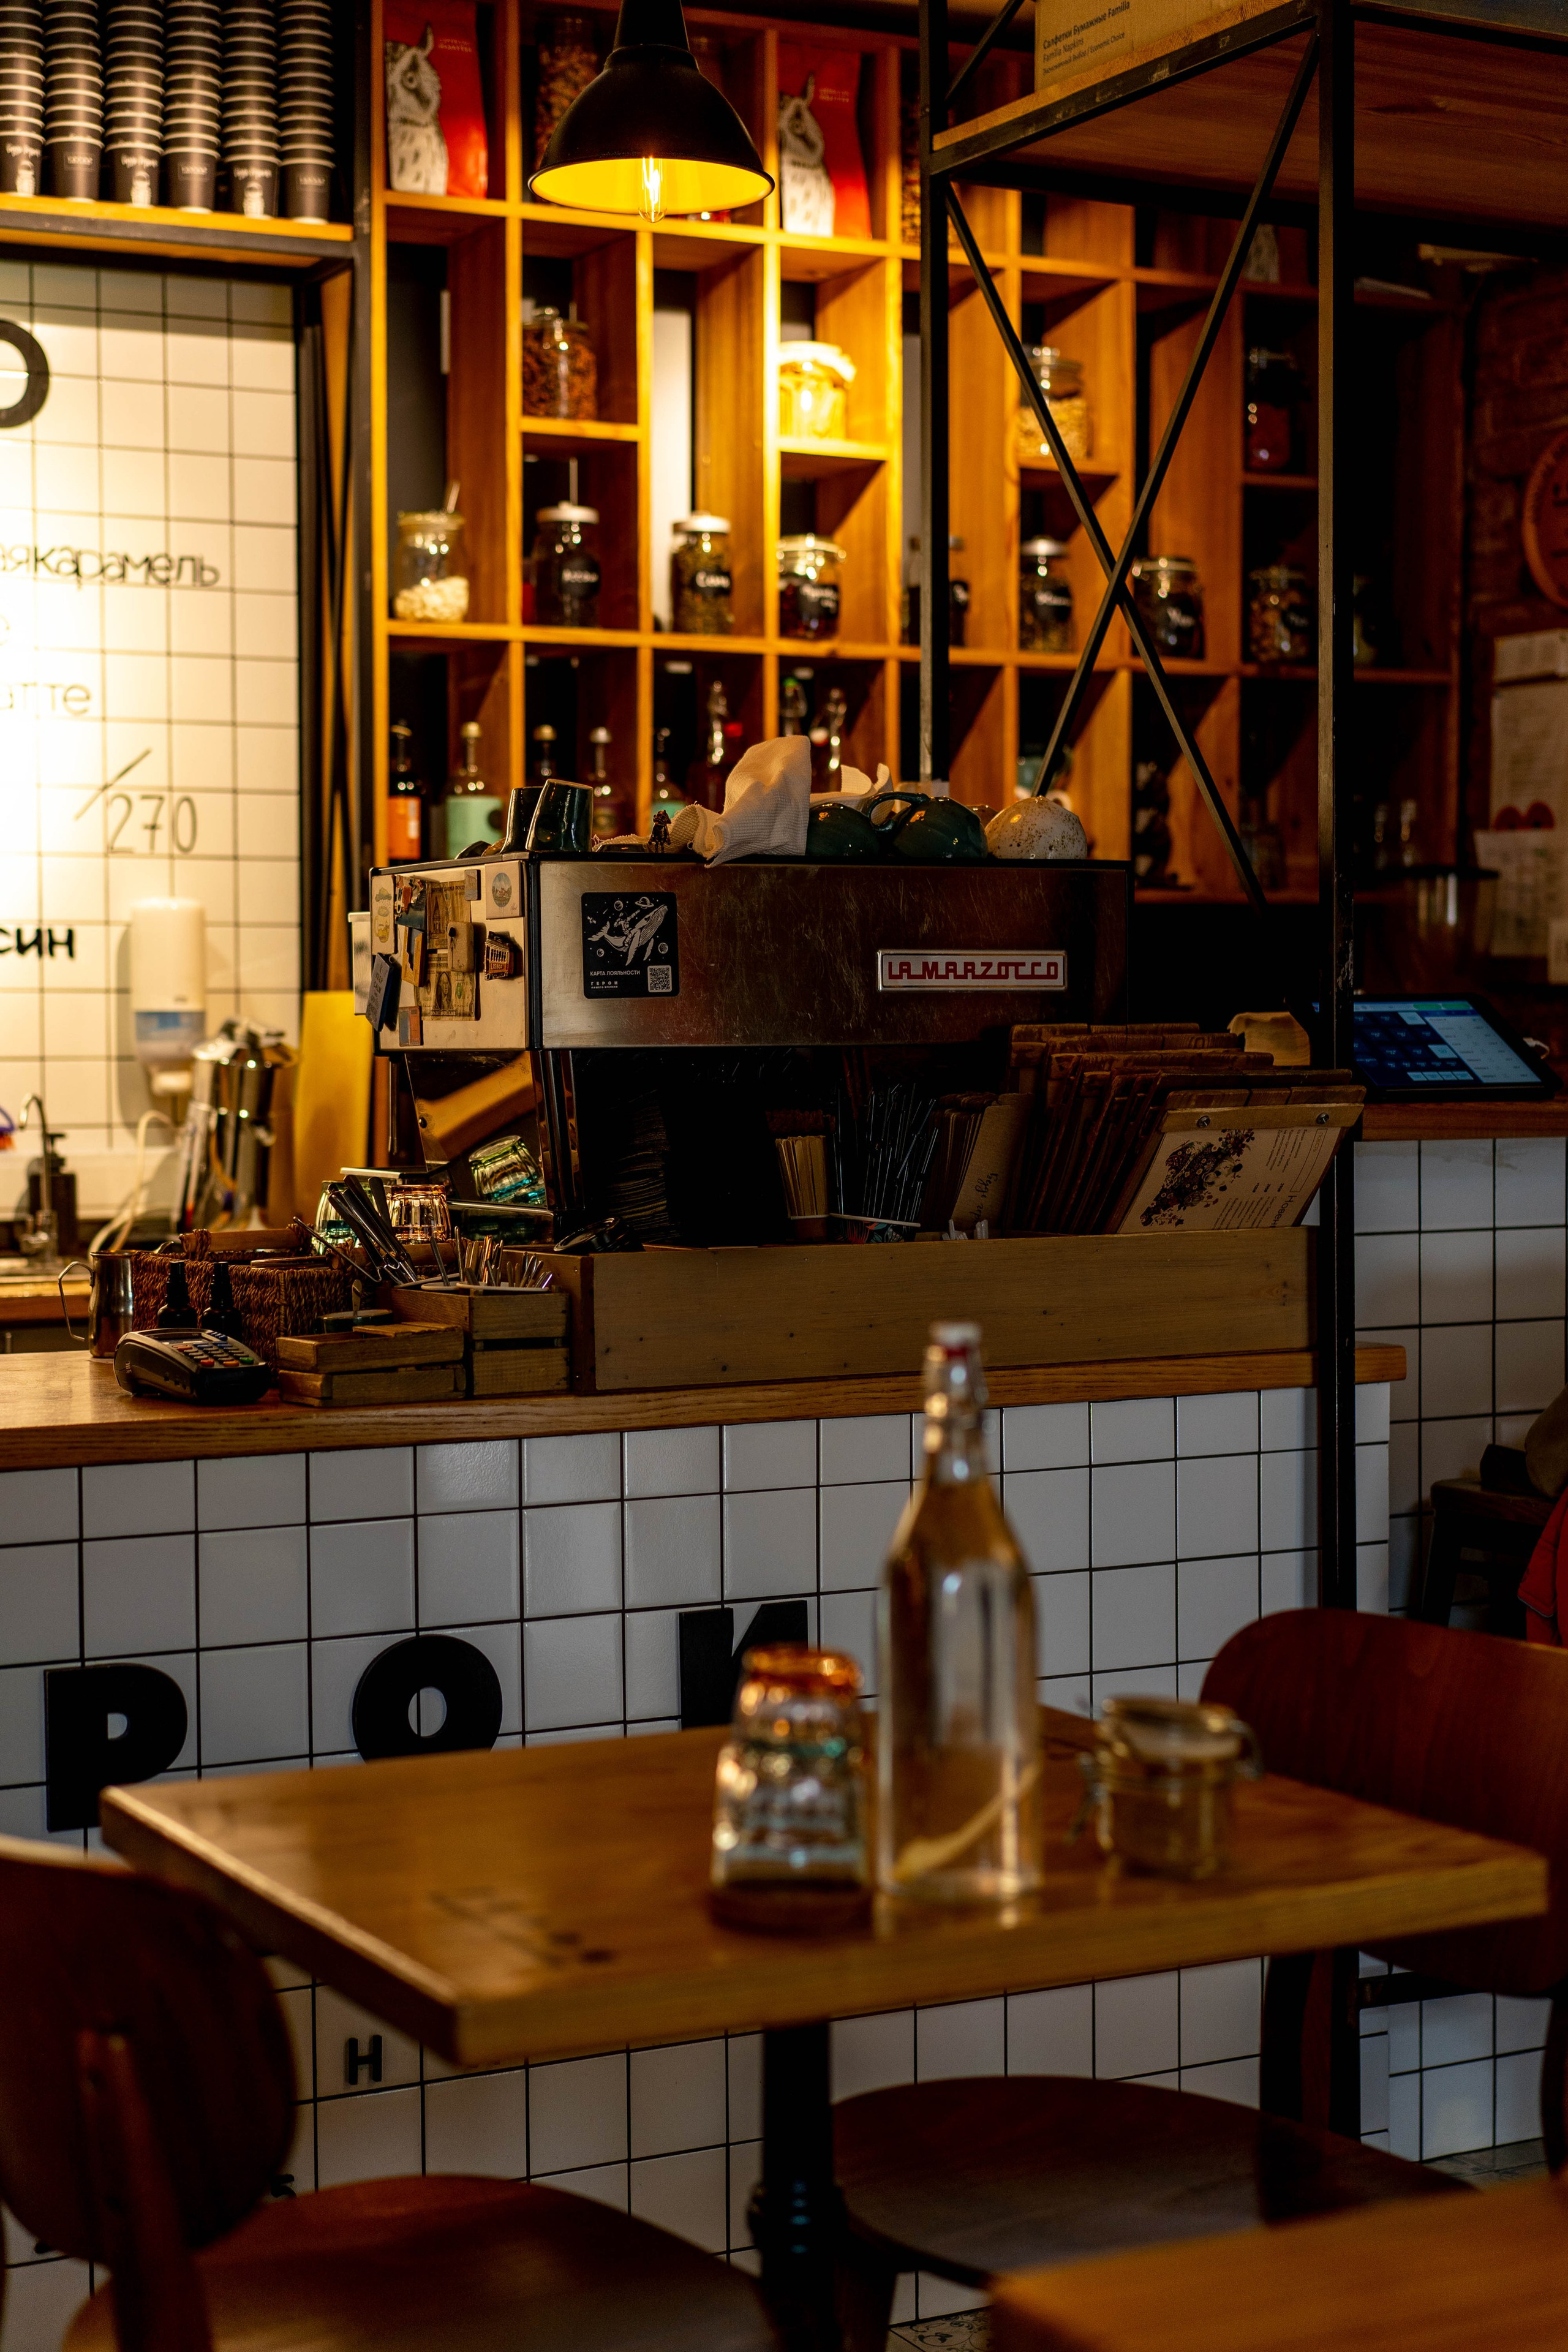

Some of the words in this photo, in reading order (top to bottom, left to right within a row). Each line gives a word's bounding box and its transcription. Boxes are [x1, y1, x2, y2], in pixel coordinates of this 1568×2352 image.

[1043, 30, 1072, 50] Салфетки
[1073, 12, 1107, 36] Бумажные
[1108, 1, 1130, 18] Familia
[1043, 48, 1061, 62] Familia
[108, 793, 198, 854] 270
[888, 962, 911, 979] LA
